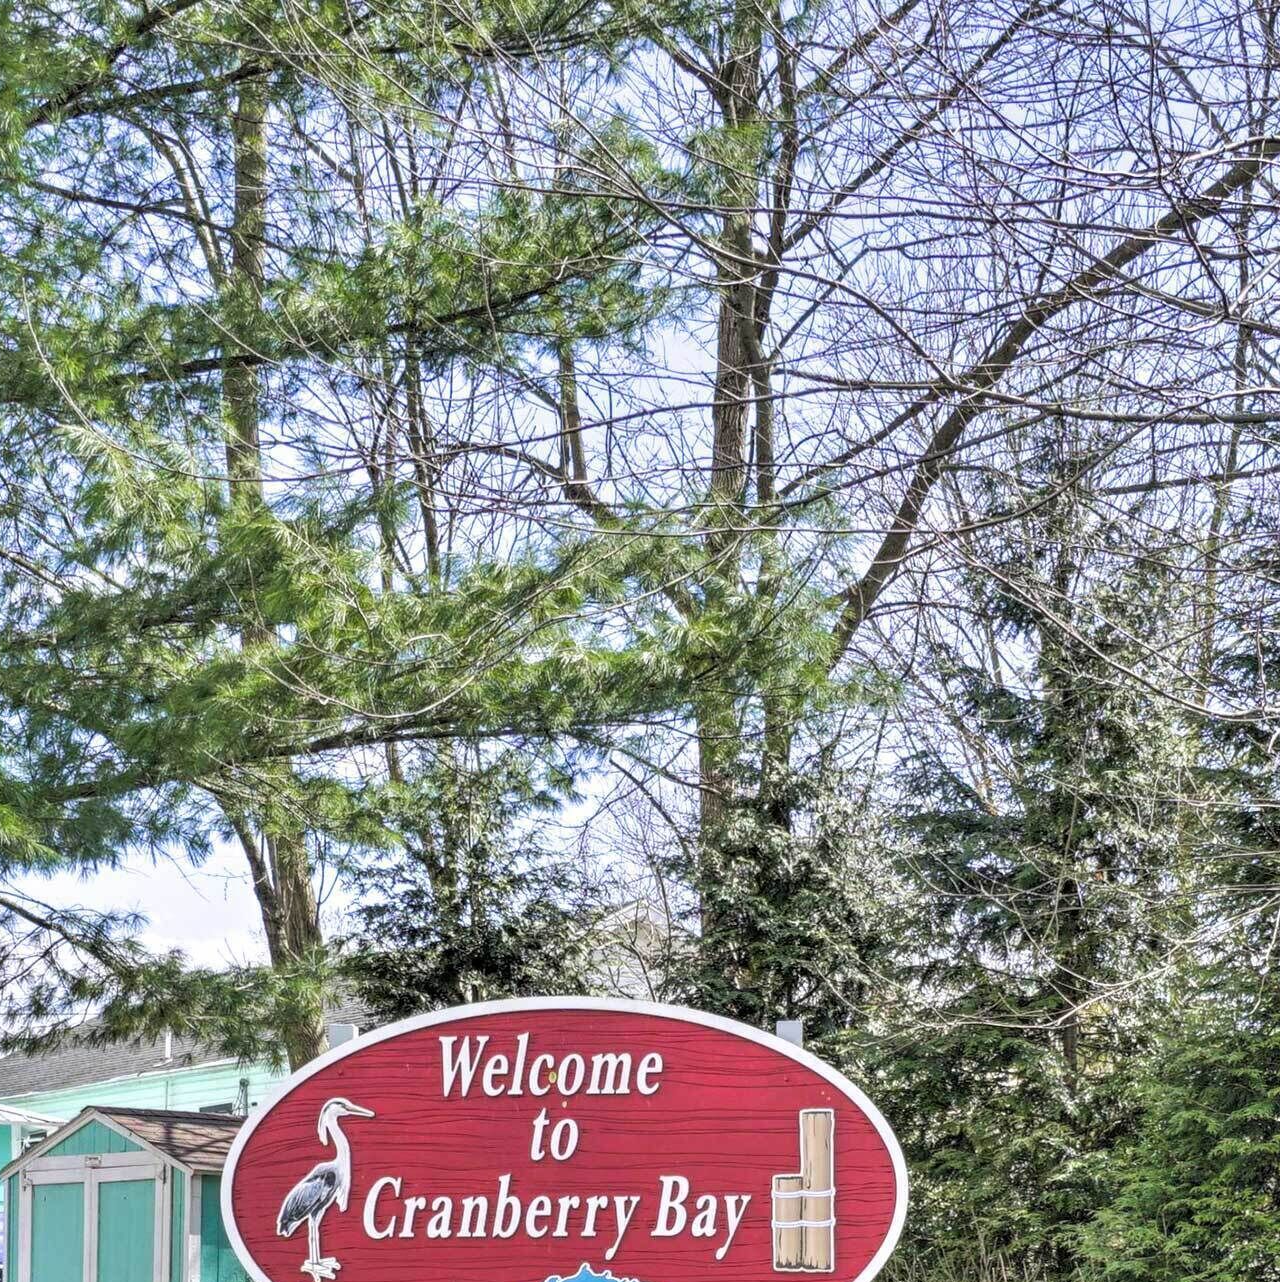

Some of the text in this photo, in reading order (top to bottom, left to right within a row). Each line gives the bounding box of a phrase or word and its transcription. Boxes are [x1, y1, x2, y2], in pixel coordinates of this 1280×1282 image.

[438, 1031, 664, 1097] Welcome
[530, 1107, 579, 1161] to
[362, 1173, 753, 1261] Cranberry Bay
